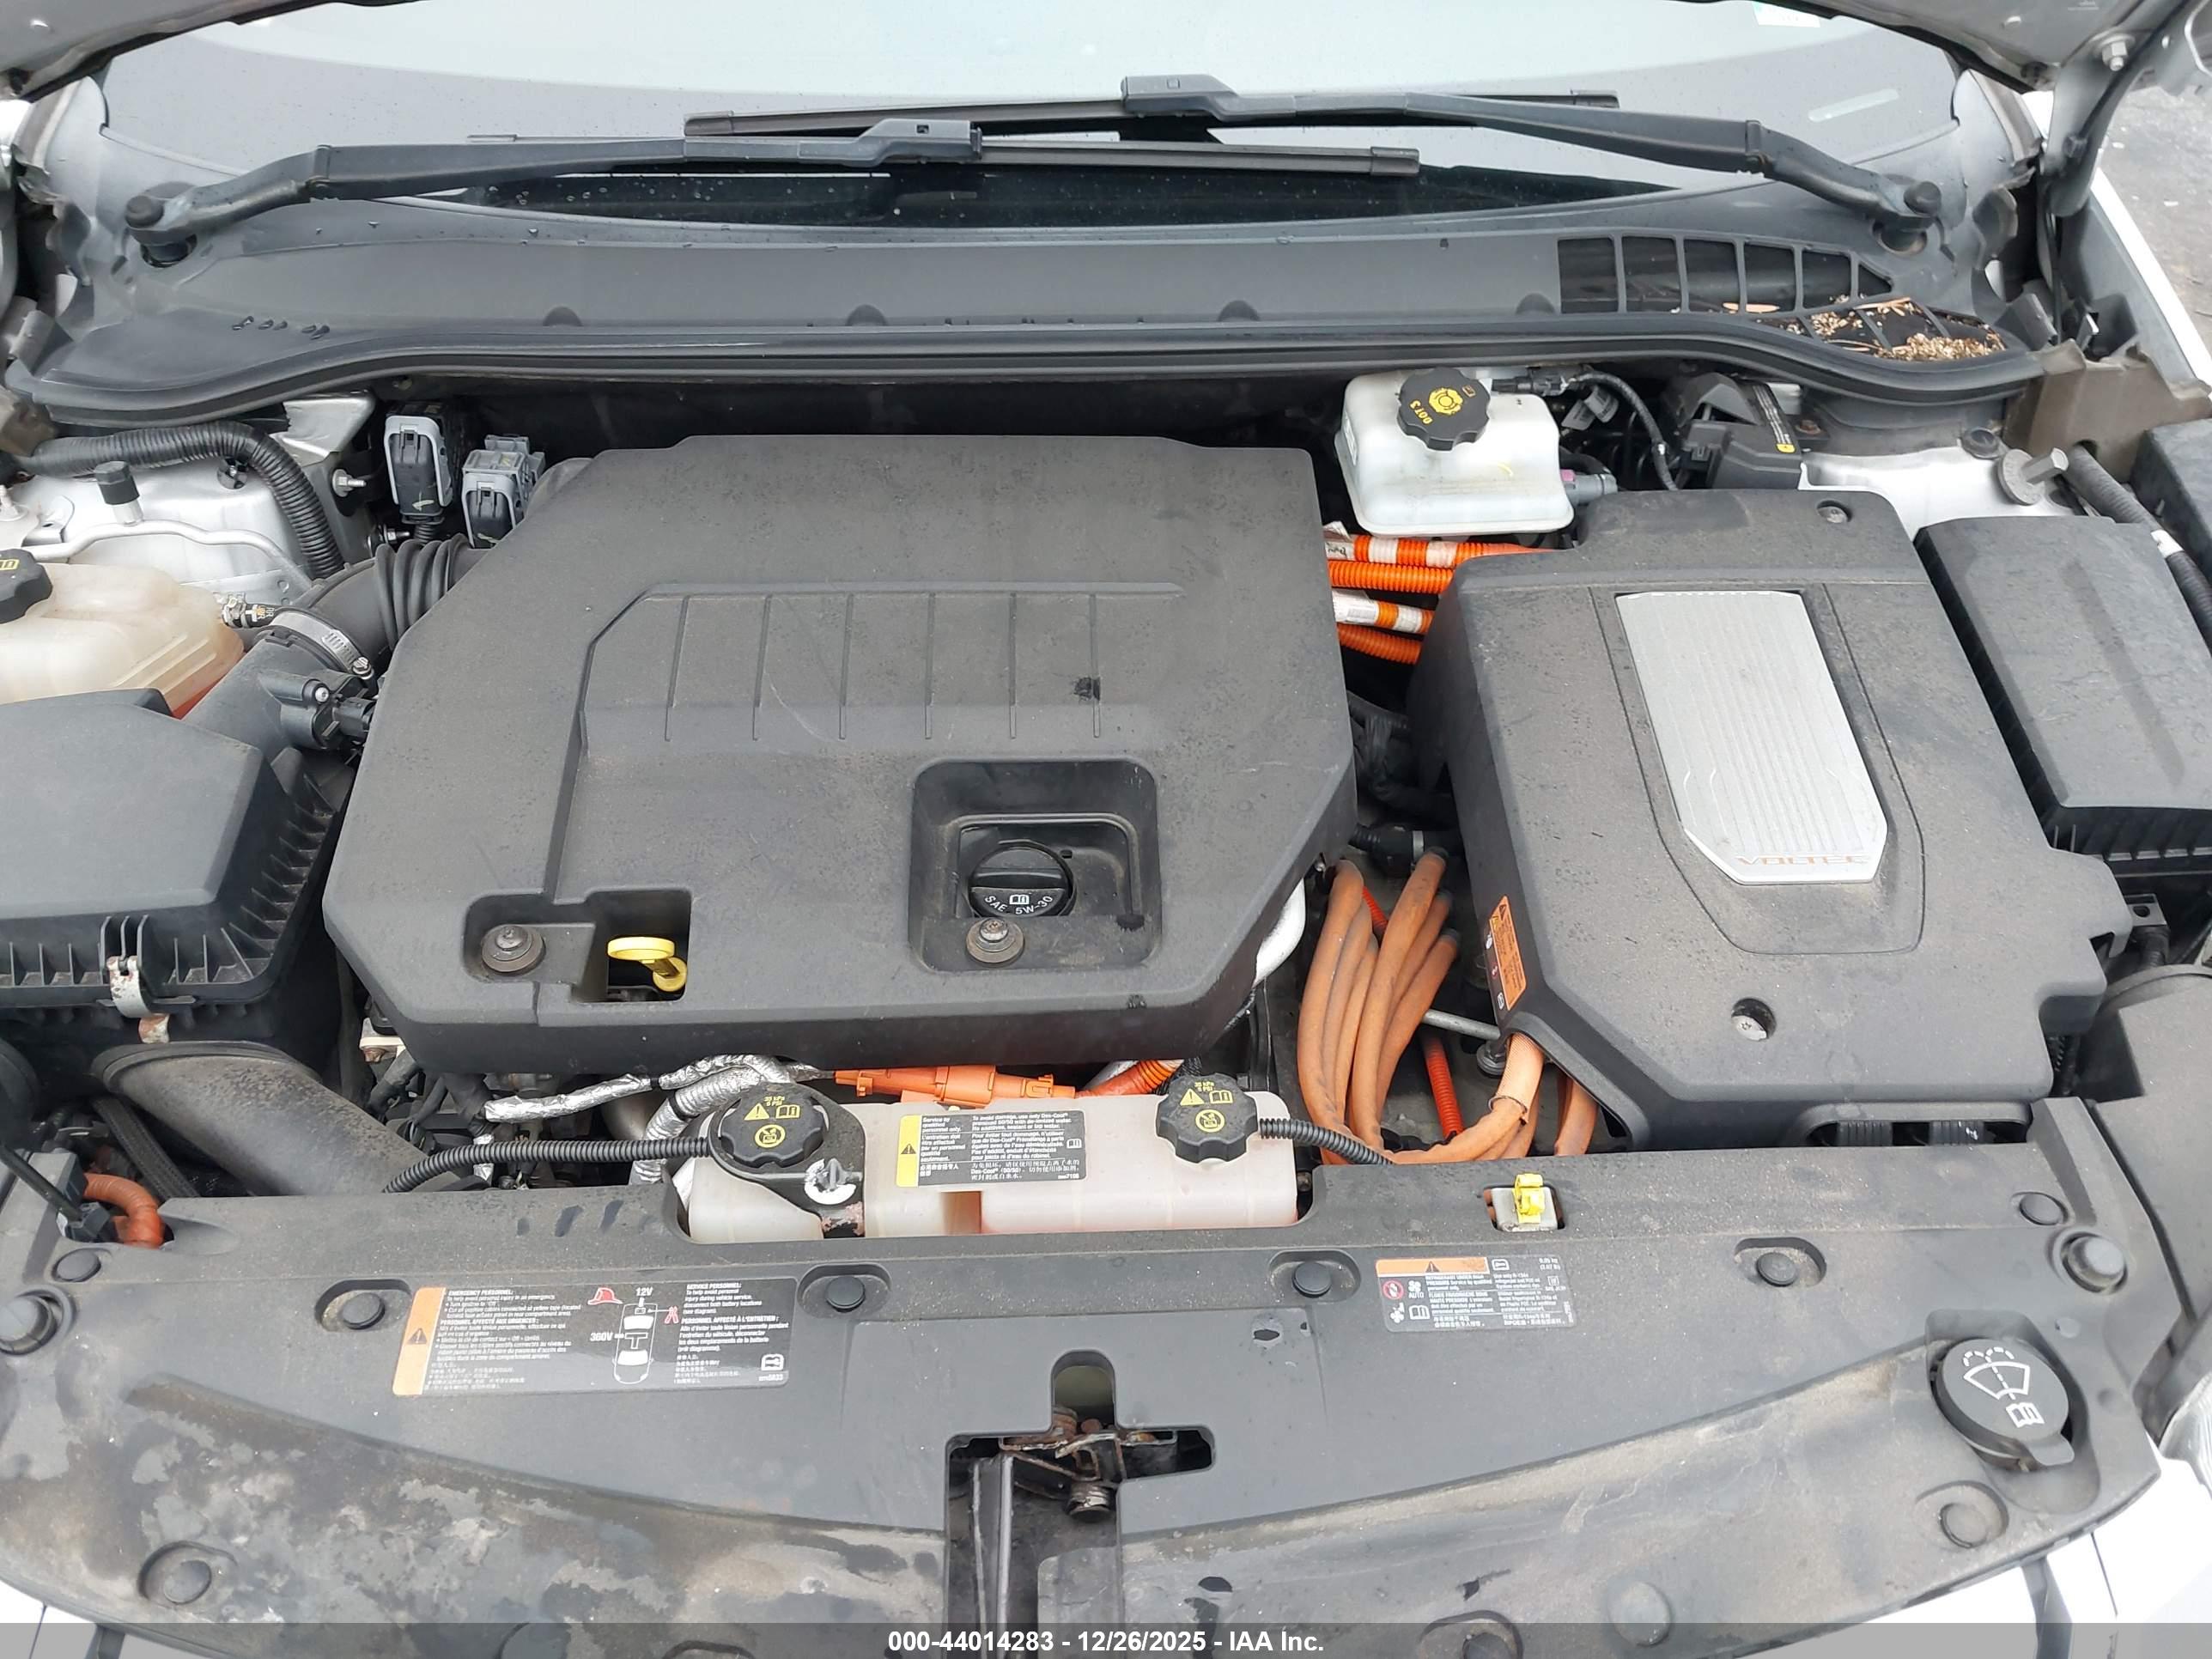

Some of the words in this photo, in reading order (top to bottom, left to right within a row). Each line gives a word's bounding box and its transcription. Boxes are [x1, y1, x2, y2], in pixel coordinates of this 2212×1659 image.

[1410, 400, 1421, 410] 3
[1414, 407, 1433, 424] DOT
[984, 896, 1008, 912] SAE
[1015, 896, 1054, 915] 5W-30
[635, 1286, 653, 1297] 12V
